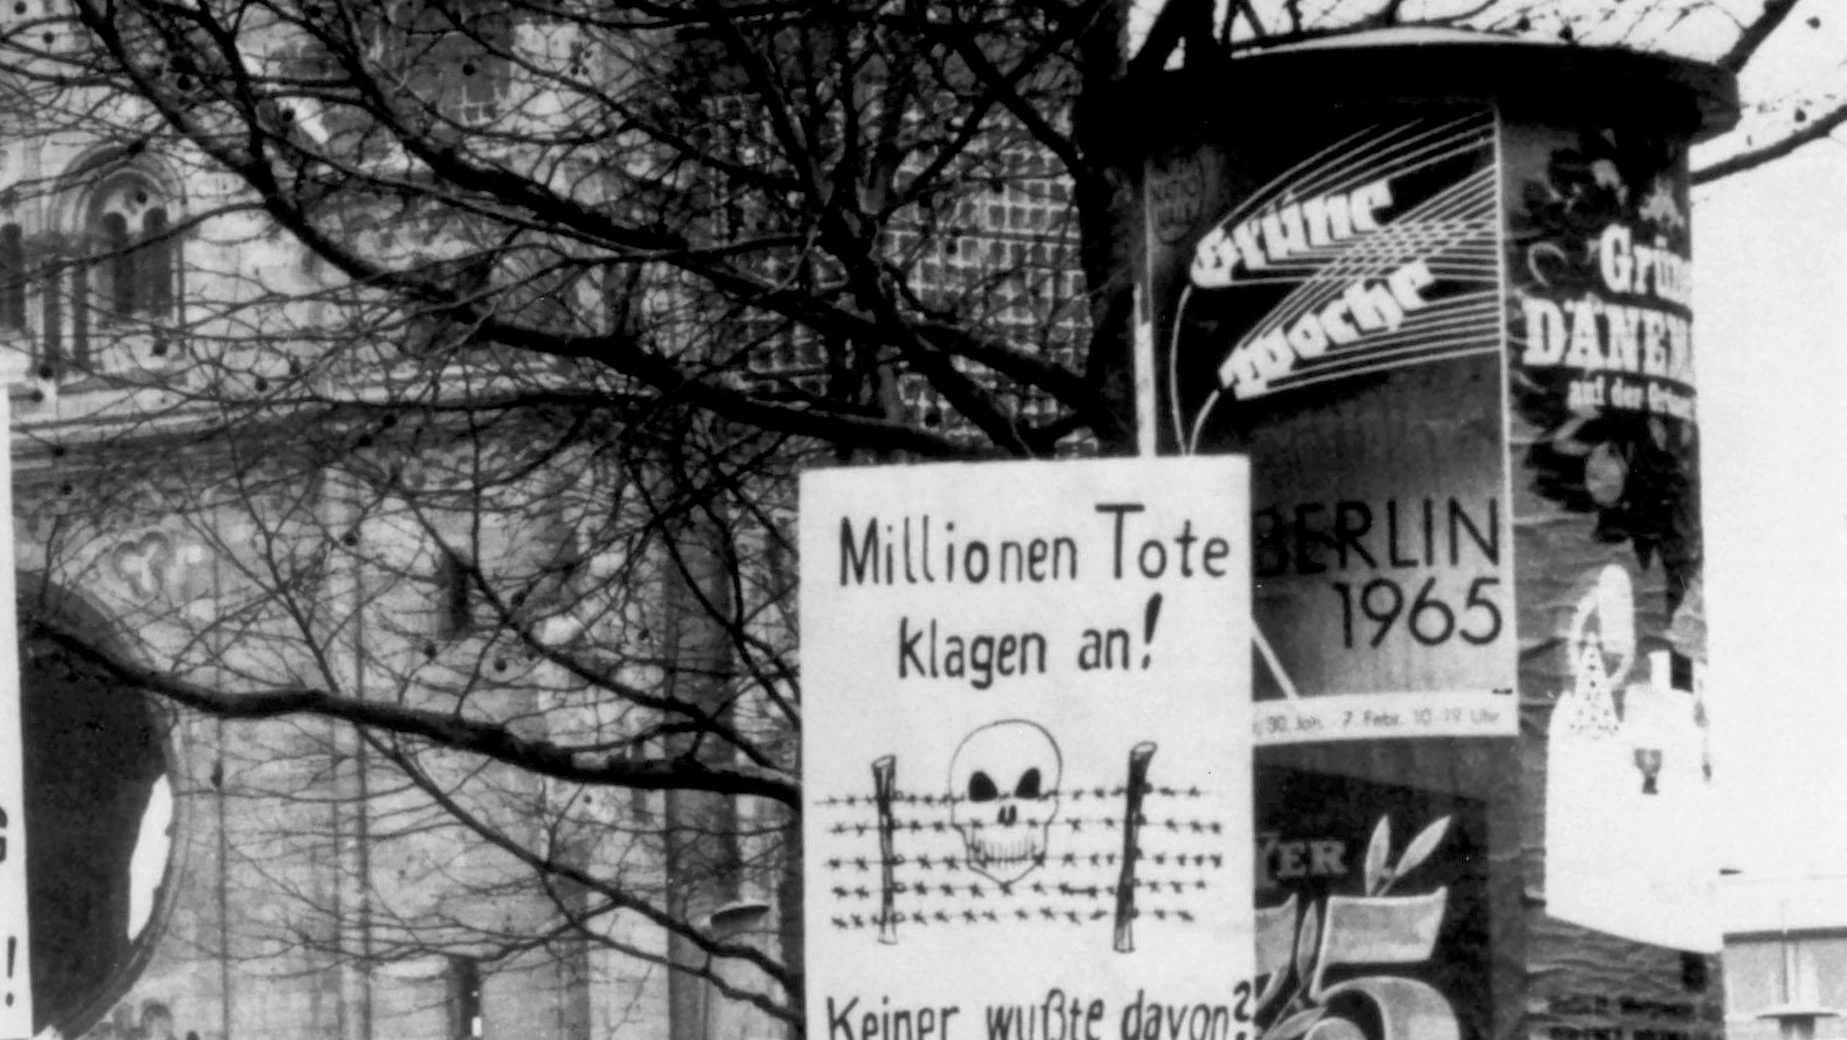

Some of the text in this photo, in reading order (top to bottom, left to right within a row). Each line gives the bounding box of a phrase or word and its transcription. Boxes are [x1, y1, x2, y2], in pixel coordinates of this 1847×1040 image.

[839, 503, 1231, 586] Millionen Tote
[1255, 498, 1500, 578] BERLIN
[898, 593, 1163, 689] klagen an!
[1333, 578, 1501, 648] 1965
